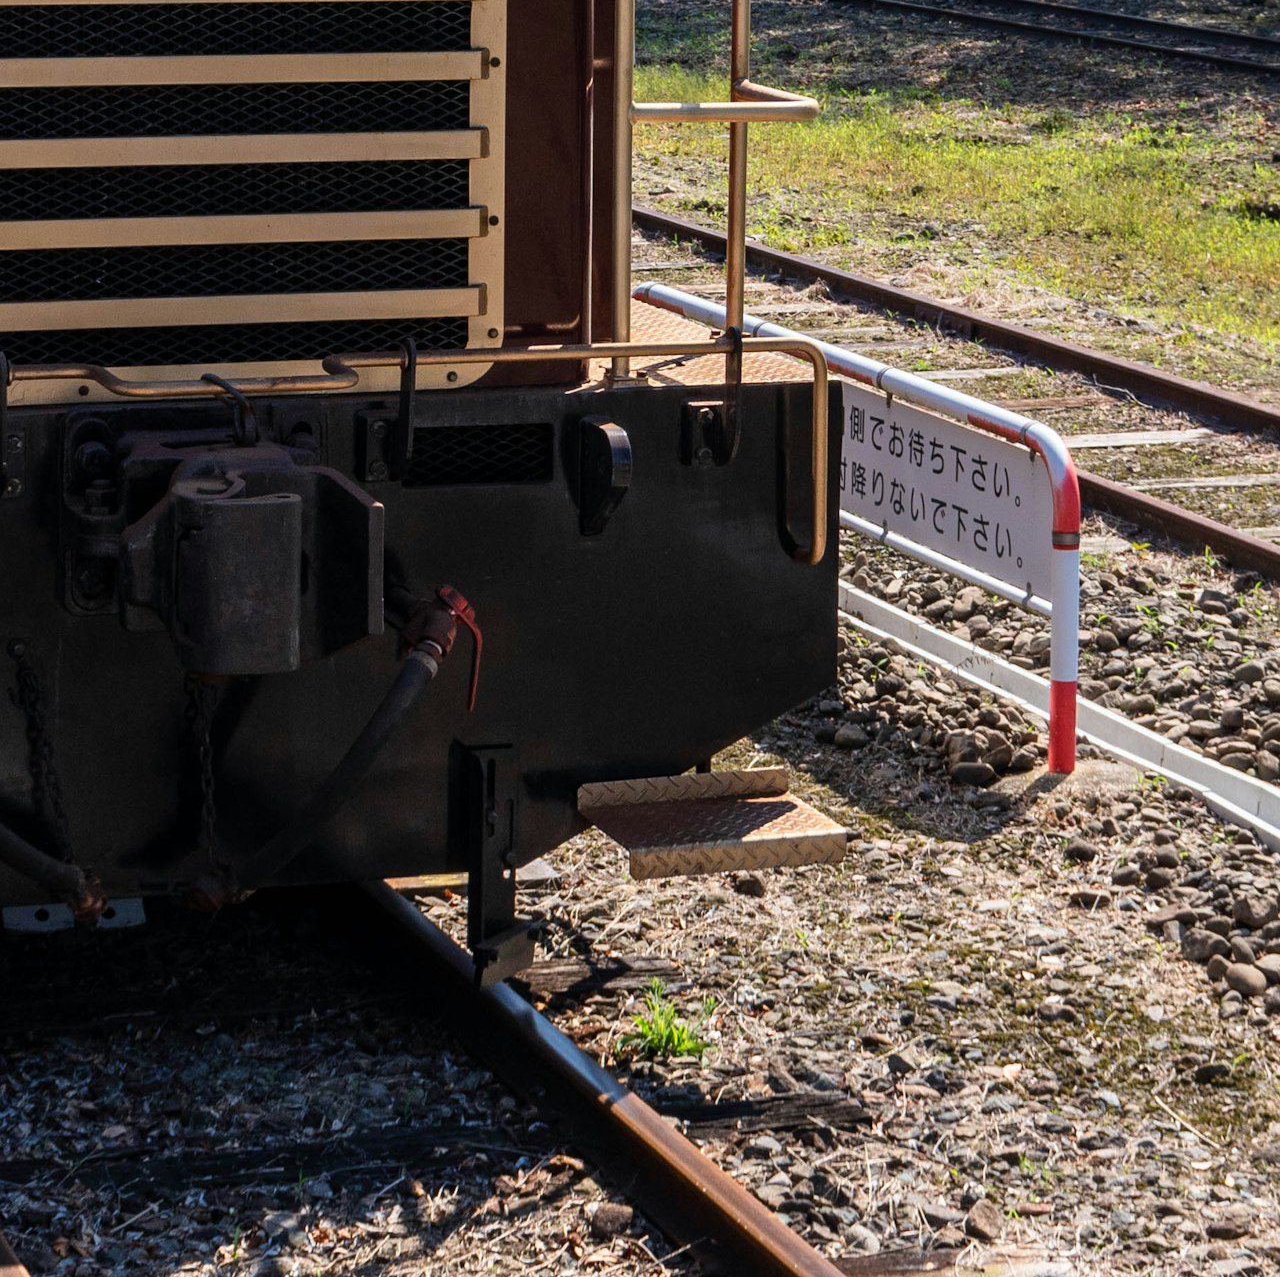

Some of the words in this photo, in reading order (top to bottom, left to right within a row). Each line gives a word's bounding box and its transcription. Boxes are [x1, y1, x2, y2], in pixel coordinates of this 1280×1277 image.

[841, 405, 1021, 508] 側でお待ち下さい。
